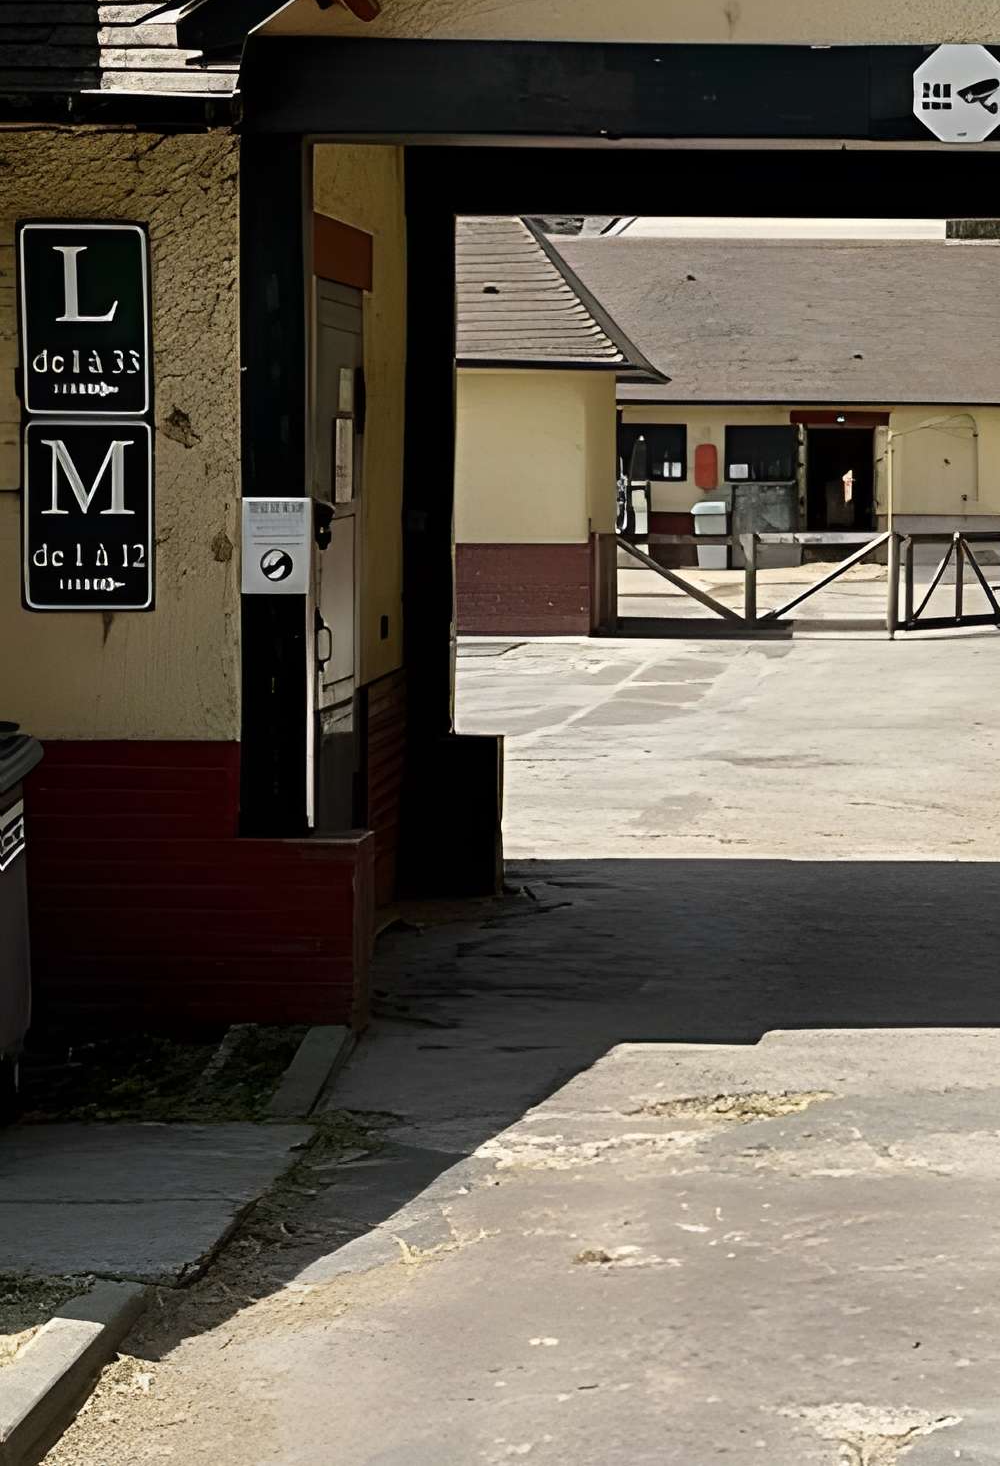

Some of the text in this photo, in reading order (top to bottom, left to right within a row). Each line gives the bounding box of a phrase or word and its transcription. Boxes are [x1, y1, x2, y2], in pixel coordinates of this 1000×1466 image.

[53, 246, 118, 321] L
[41, 440, 135, 514] M
[122, 544, 145, 567] 12
